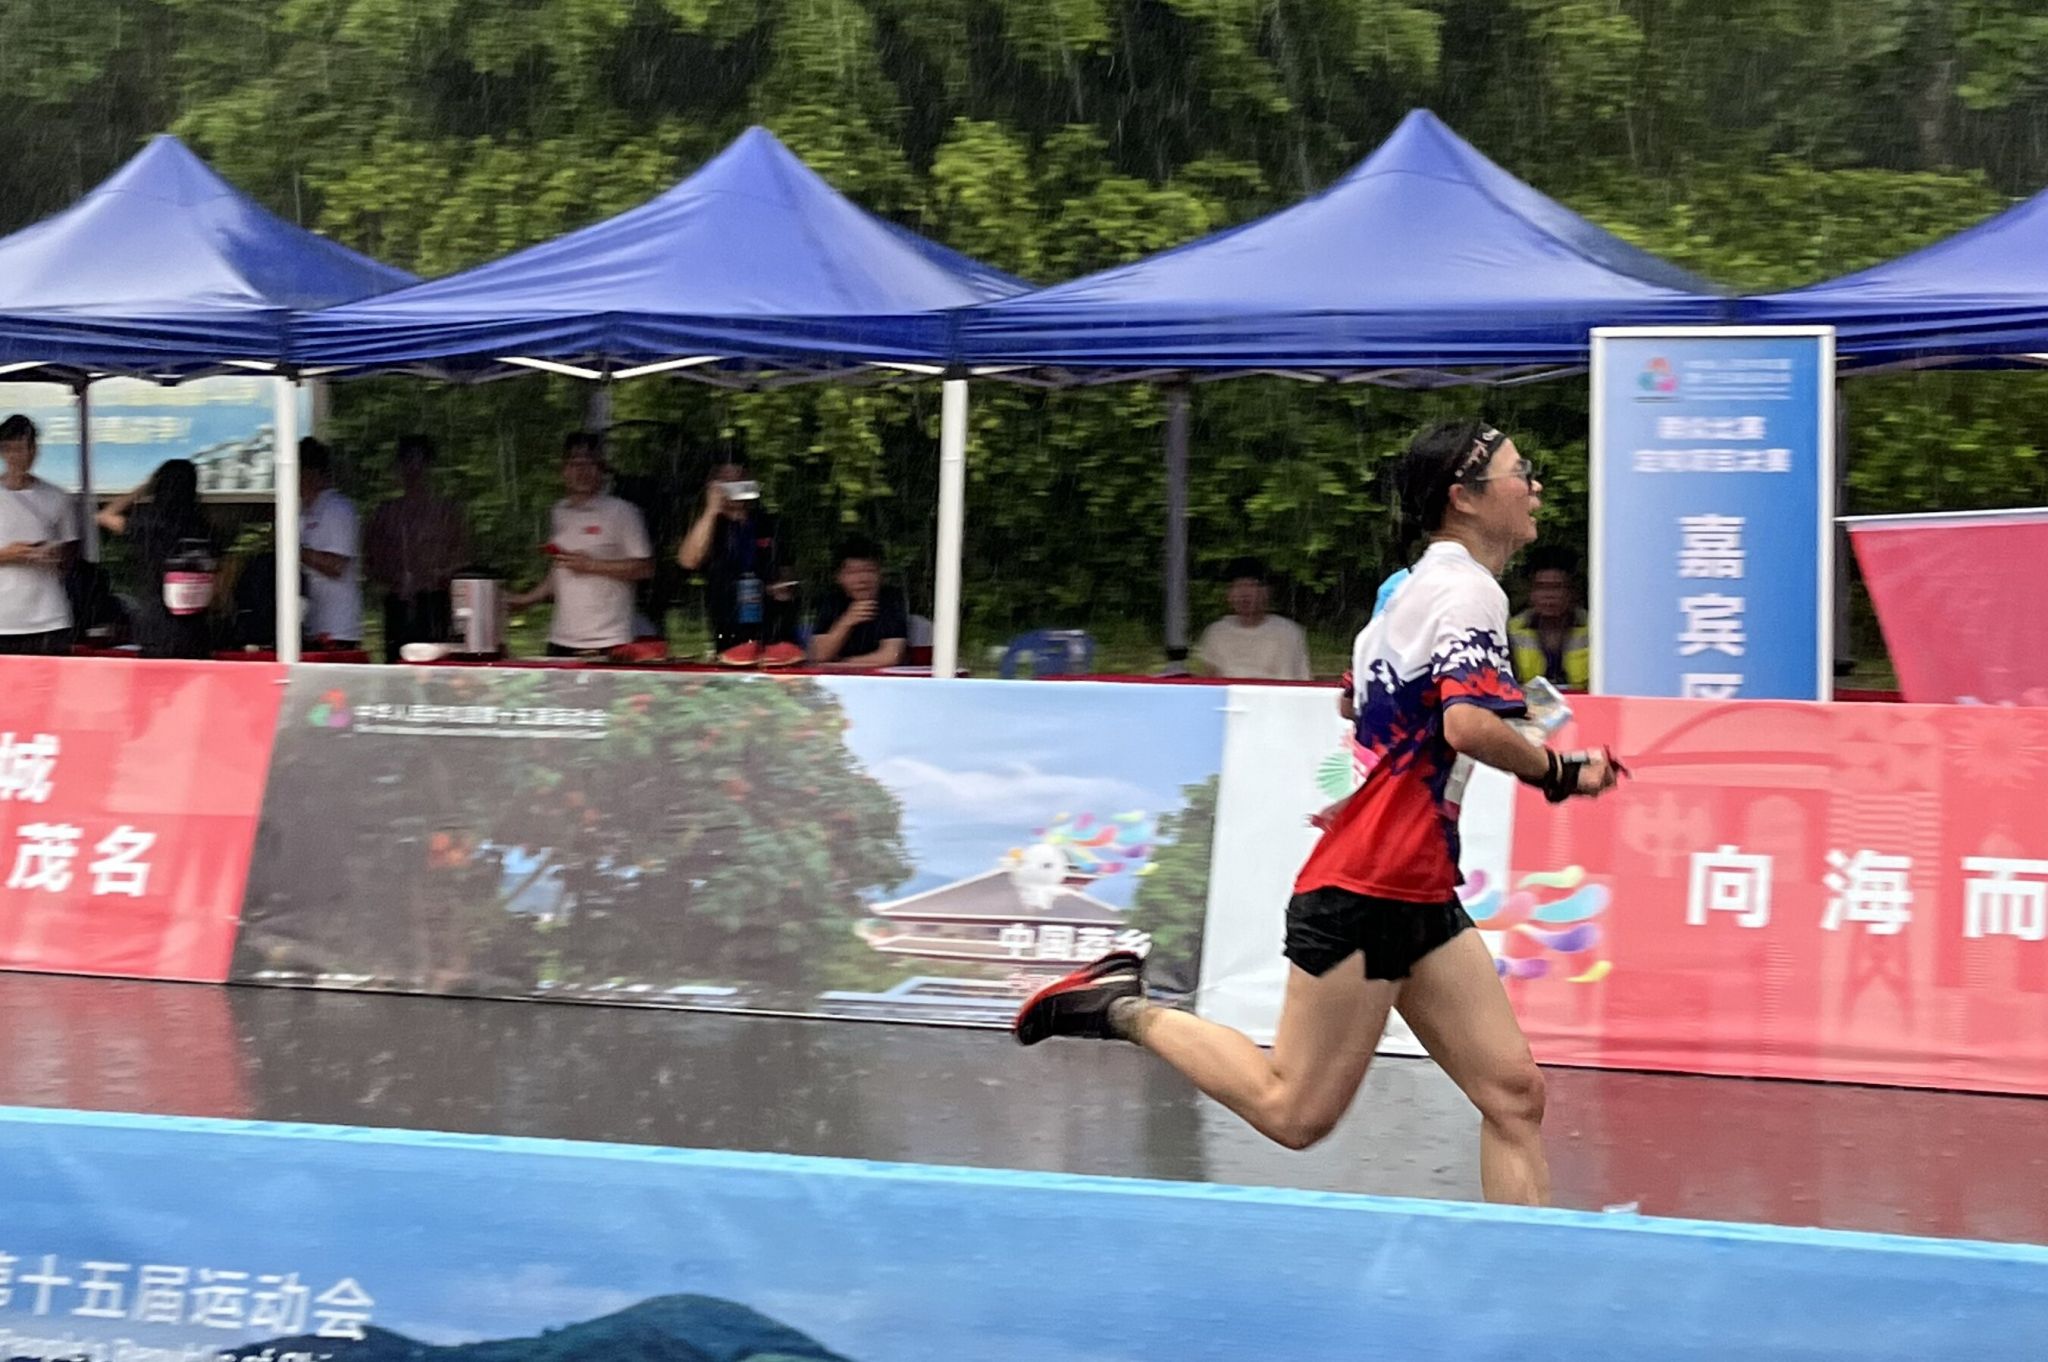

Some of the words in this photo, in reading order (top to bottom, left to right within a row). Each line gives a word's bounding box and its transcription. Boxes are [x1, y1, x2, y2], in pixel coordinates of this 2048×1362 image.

[6, 822, 158, 898] 茂名
[1686, 844, 2046, 941] 向海而
